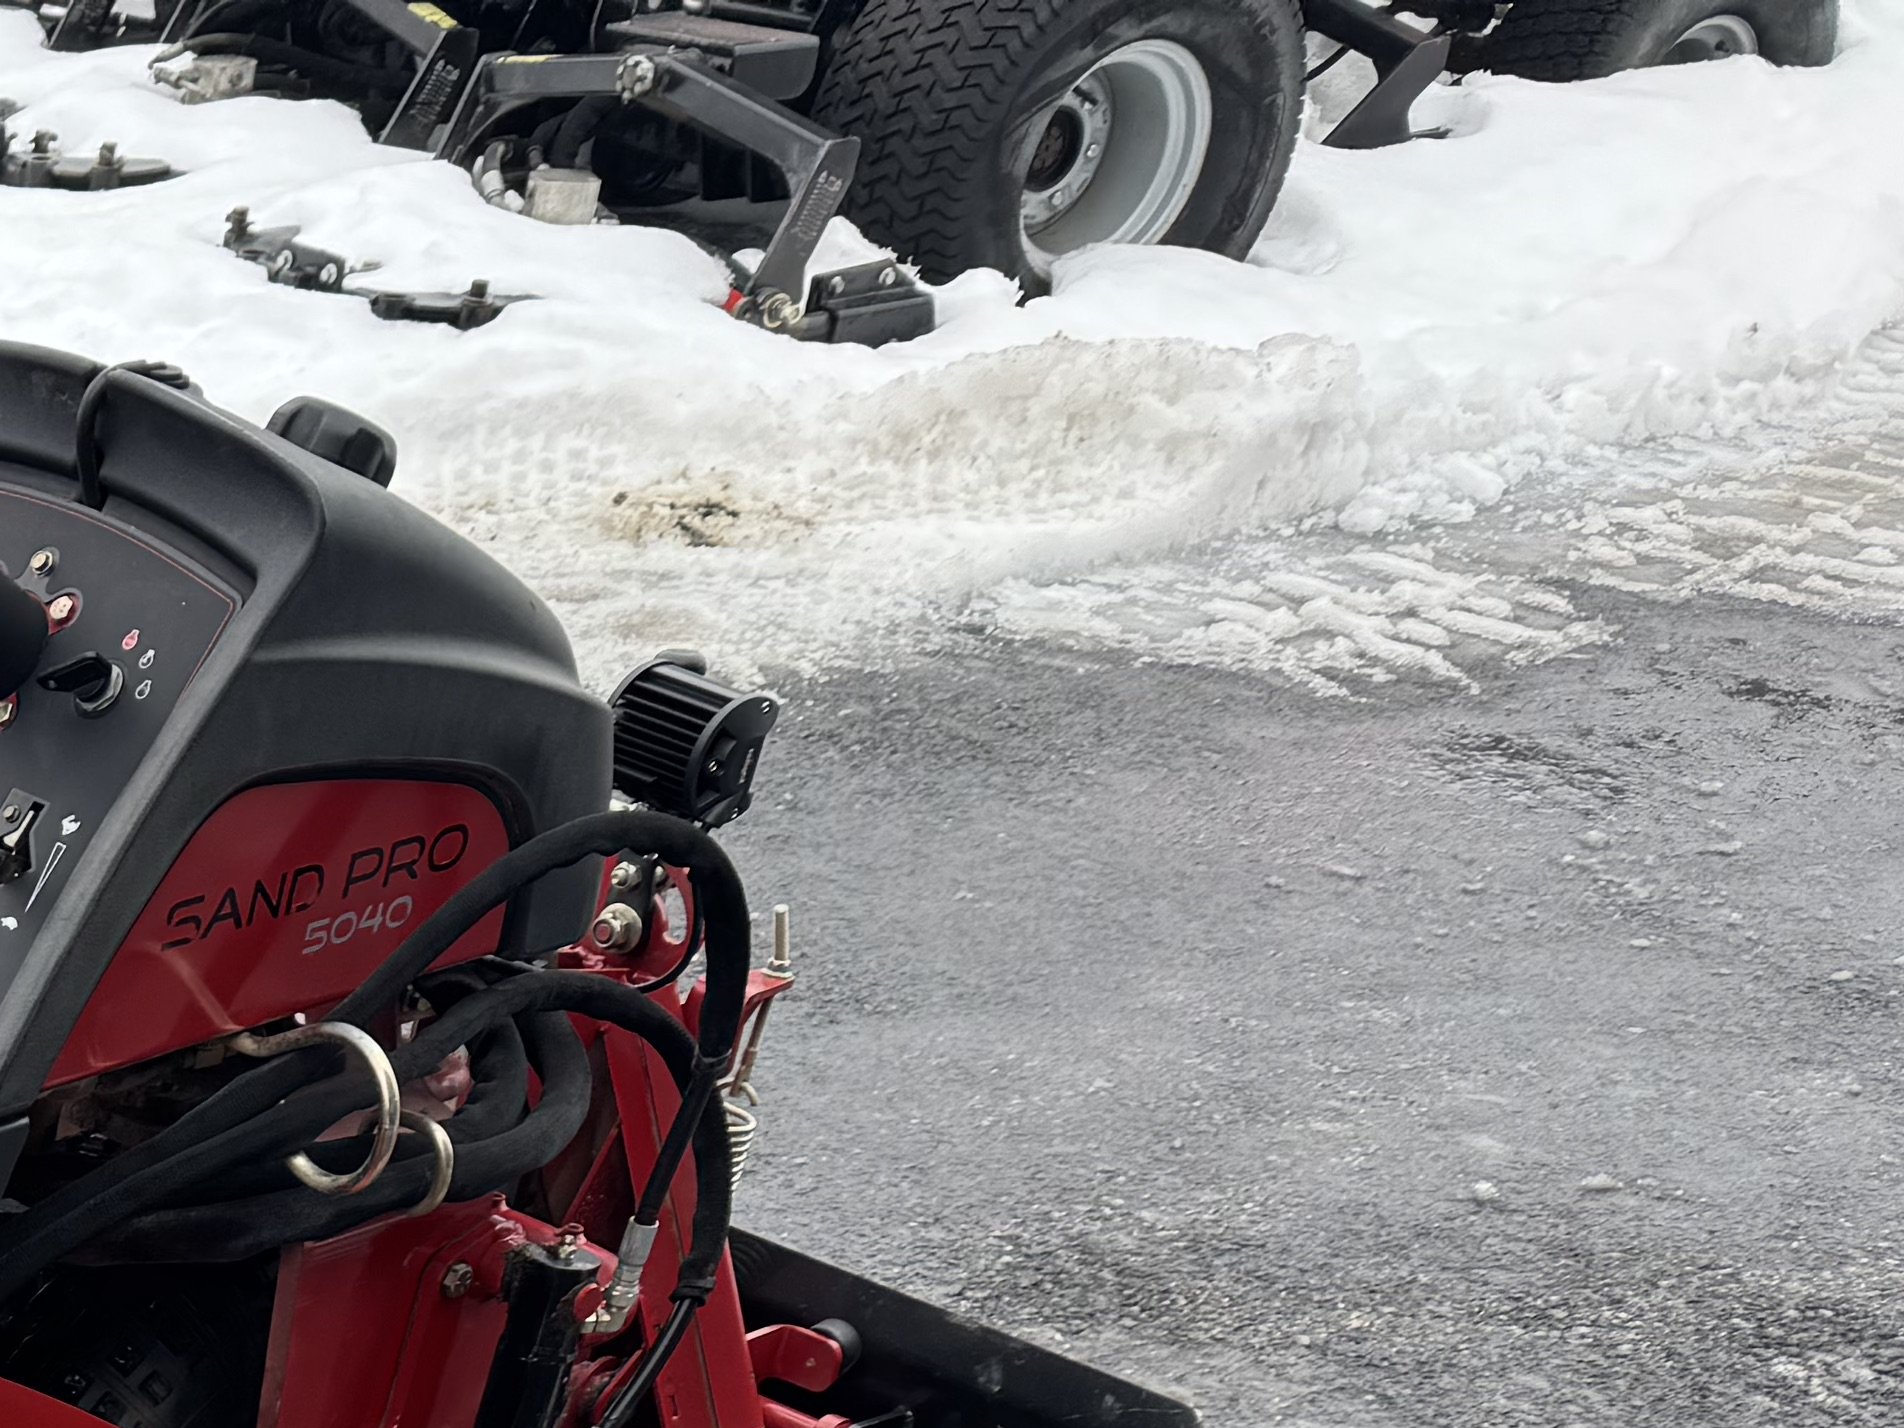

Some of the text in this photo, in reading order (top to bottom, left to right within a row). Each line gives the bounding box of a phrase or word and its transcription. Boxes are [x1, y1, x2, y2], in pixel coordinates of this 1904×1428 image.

[162, 824, 469, 950] SAND PRO
[302, 896, 414, 955] 5040
